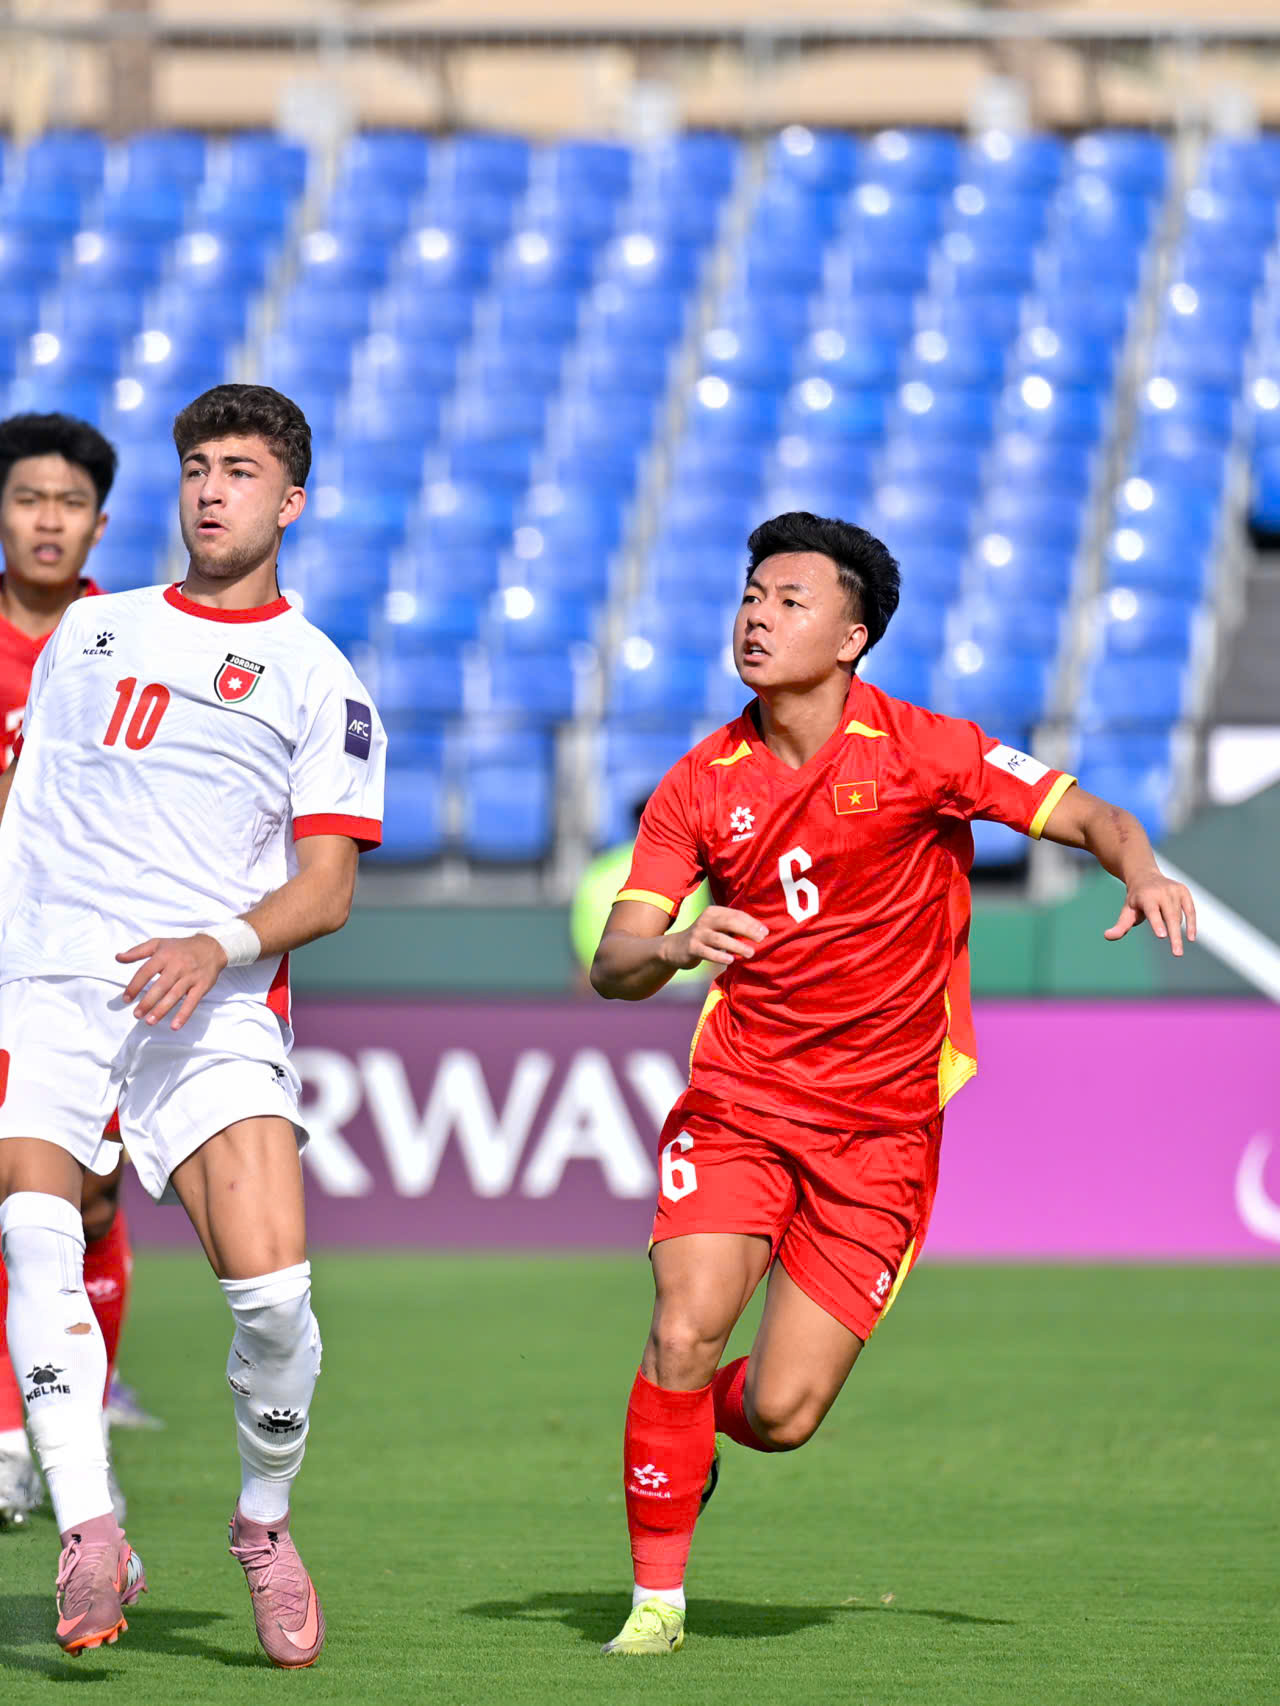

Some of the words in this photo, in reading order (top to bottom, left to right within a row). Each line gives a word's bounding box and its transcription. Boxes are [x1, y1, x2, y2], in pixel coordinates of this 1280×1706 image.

[82, 648, 114, 657] KELME
[229, 655, 261, 673] JORDAN
[102, 677, 170, 751] 10
[348, 718, 370, 738] AFC
[778, 846, 819, 923] 6
[661, 1130, 698, 1203] 6
[26, 1384, 71, 1403] KELME
[258, 1421, 303, 1433] KELME
